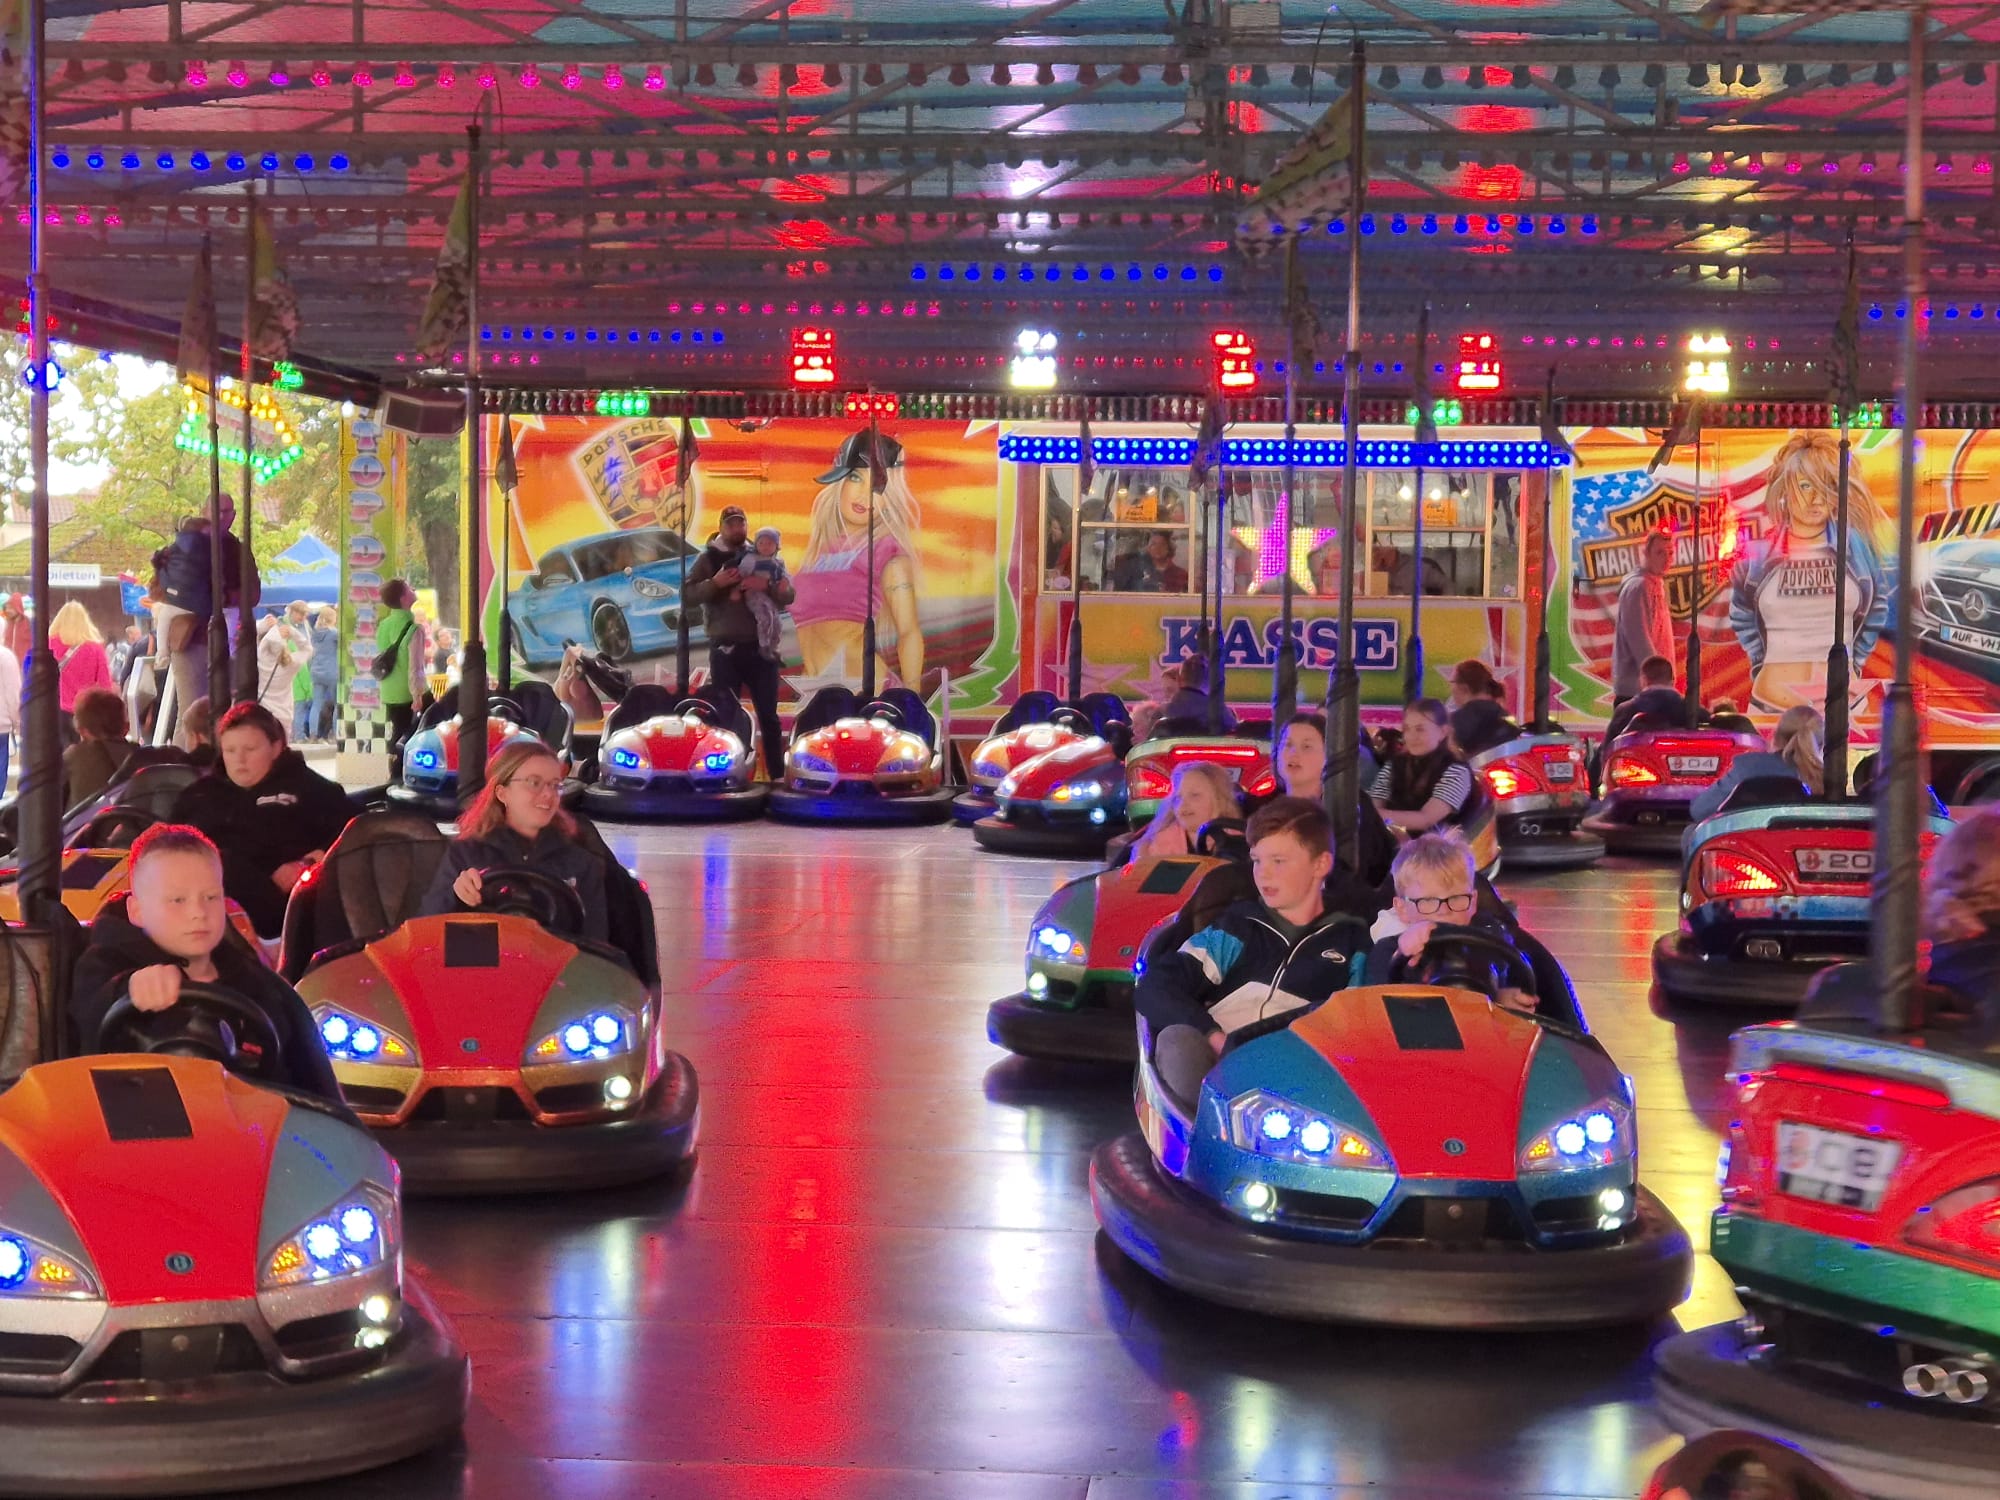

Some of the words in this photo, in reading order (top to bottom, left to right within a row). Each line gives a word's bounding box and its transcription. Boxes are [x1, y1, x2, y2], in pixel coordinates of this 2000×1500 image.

[582, 420, 667, 465] PORSCHE
[50, 568, 96, 580] iletten
[1780, 567, 1837, 588] ADVISORY
[1161, 616, 1398, 670] KASSE
[1688, 757, 1714, 769] 04
[1829, 853, 1872, 869] 20
